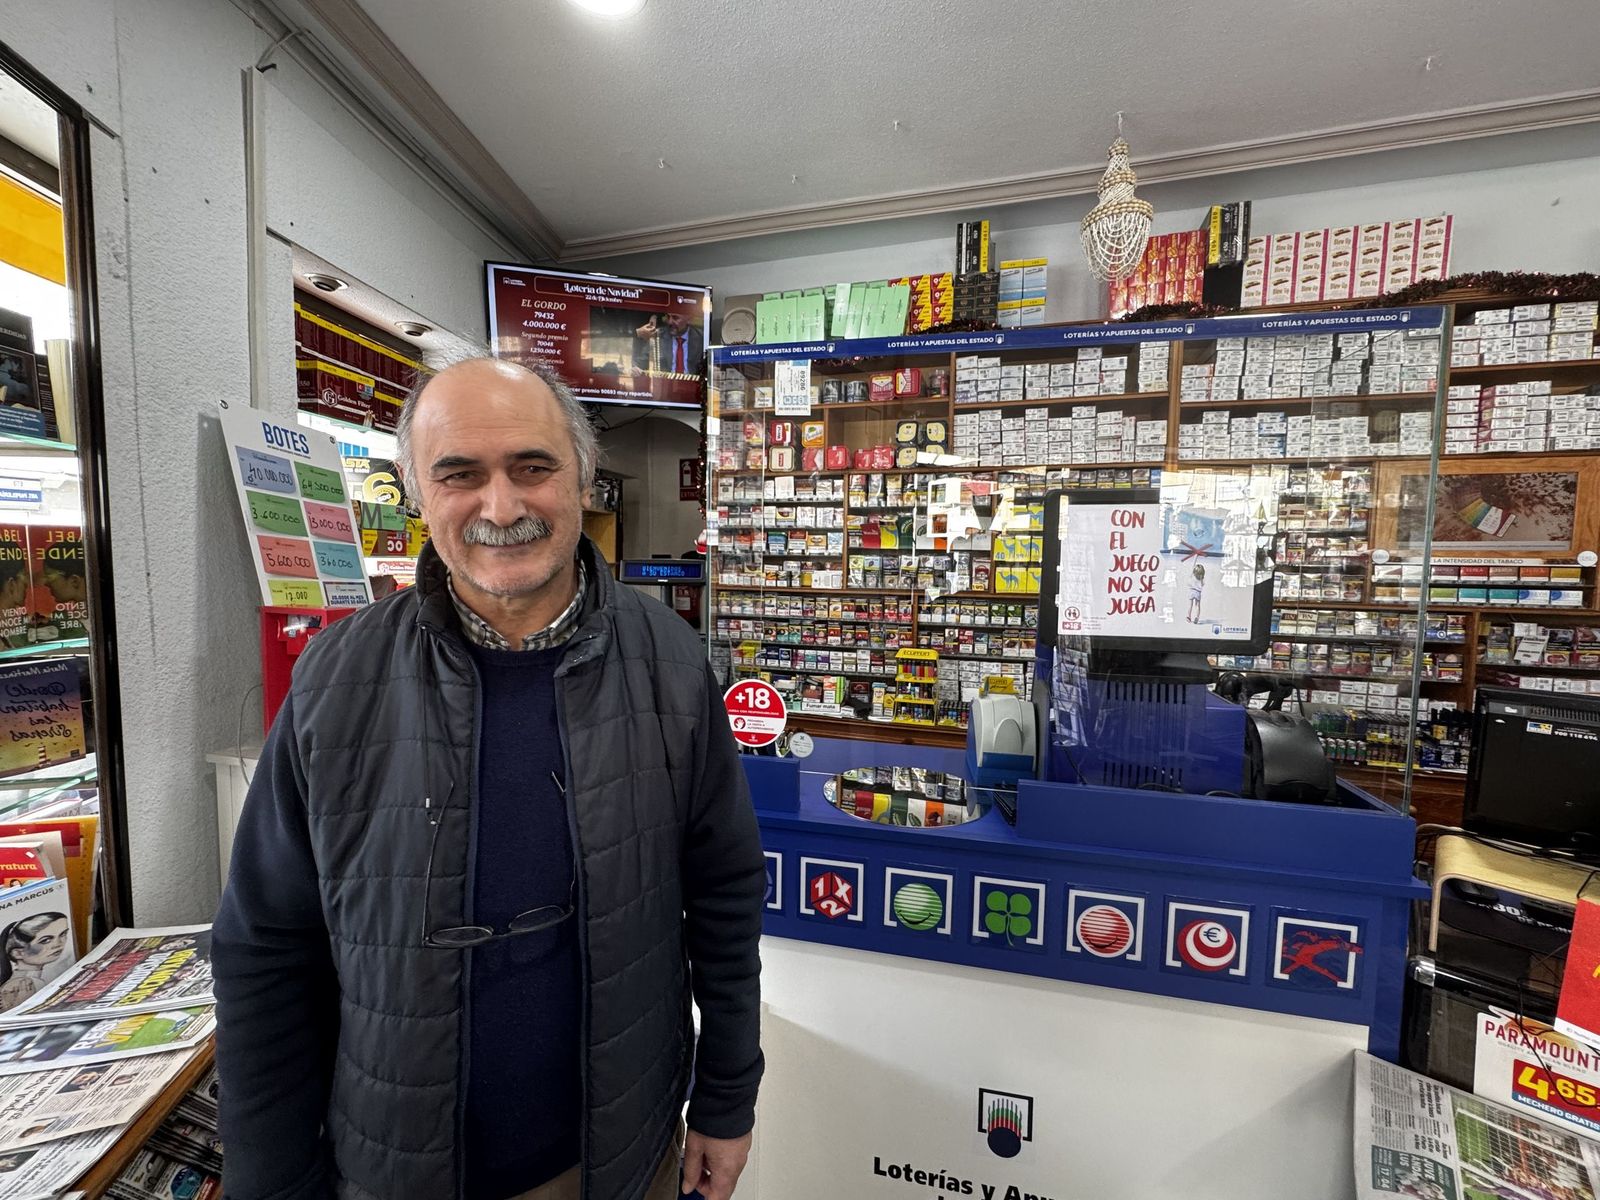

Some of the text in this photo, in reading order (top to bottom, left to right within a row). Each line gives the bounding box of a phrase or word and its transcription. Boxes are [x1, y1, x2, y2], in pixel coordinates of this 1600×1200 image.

[595, 286, 606, 295] de
[521, 298, 567, 311] EL GORDO
[534, 311, 555, 320] 79432
[1262, 319, 1302, 328] LOTERÍAS
[1366, 314, 1398, 322] ESTADO
[522, 320, 567, 331] 4.000.000 €
[521, 331, 547, 340] Segundo
[887, 340, 919, 348] LOTERÍAS
[338, 394, 372, 409] Golden Filter
[262, 421, 310, 455] BOTES
[1110, 509, 1145, 529] CON
[1109, 531, 1128, 551] EL
[1108, 554, 1160, 573] JUEGO
[1108, 574, 1157, 594] NO SE
[2, 606, 27, 618] VIENTO
[1107, 596, 1156, 616] JUEGA
[734, 687, 771, 709] +18
[1485, 1020, 1600, 1072] PARAMOUNT
[1517, 1094, 1600, 1130] MECHERO GRATIS
[1399, 1152, 1410, 1167] LUS
[873, 1156, 974, 1195] Loterías
[1423, 1158, 1435, 1181] JUVE
